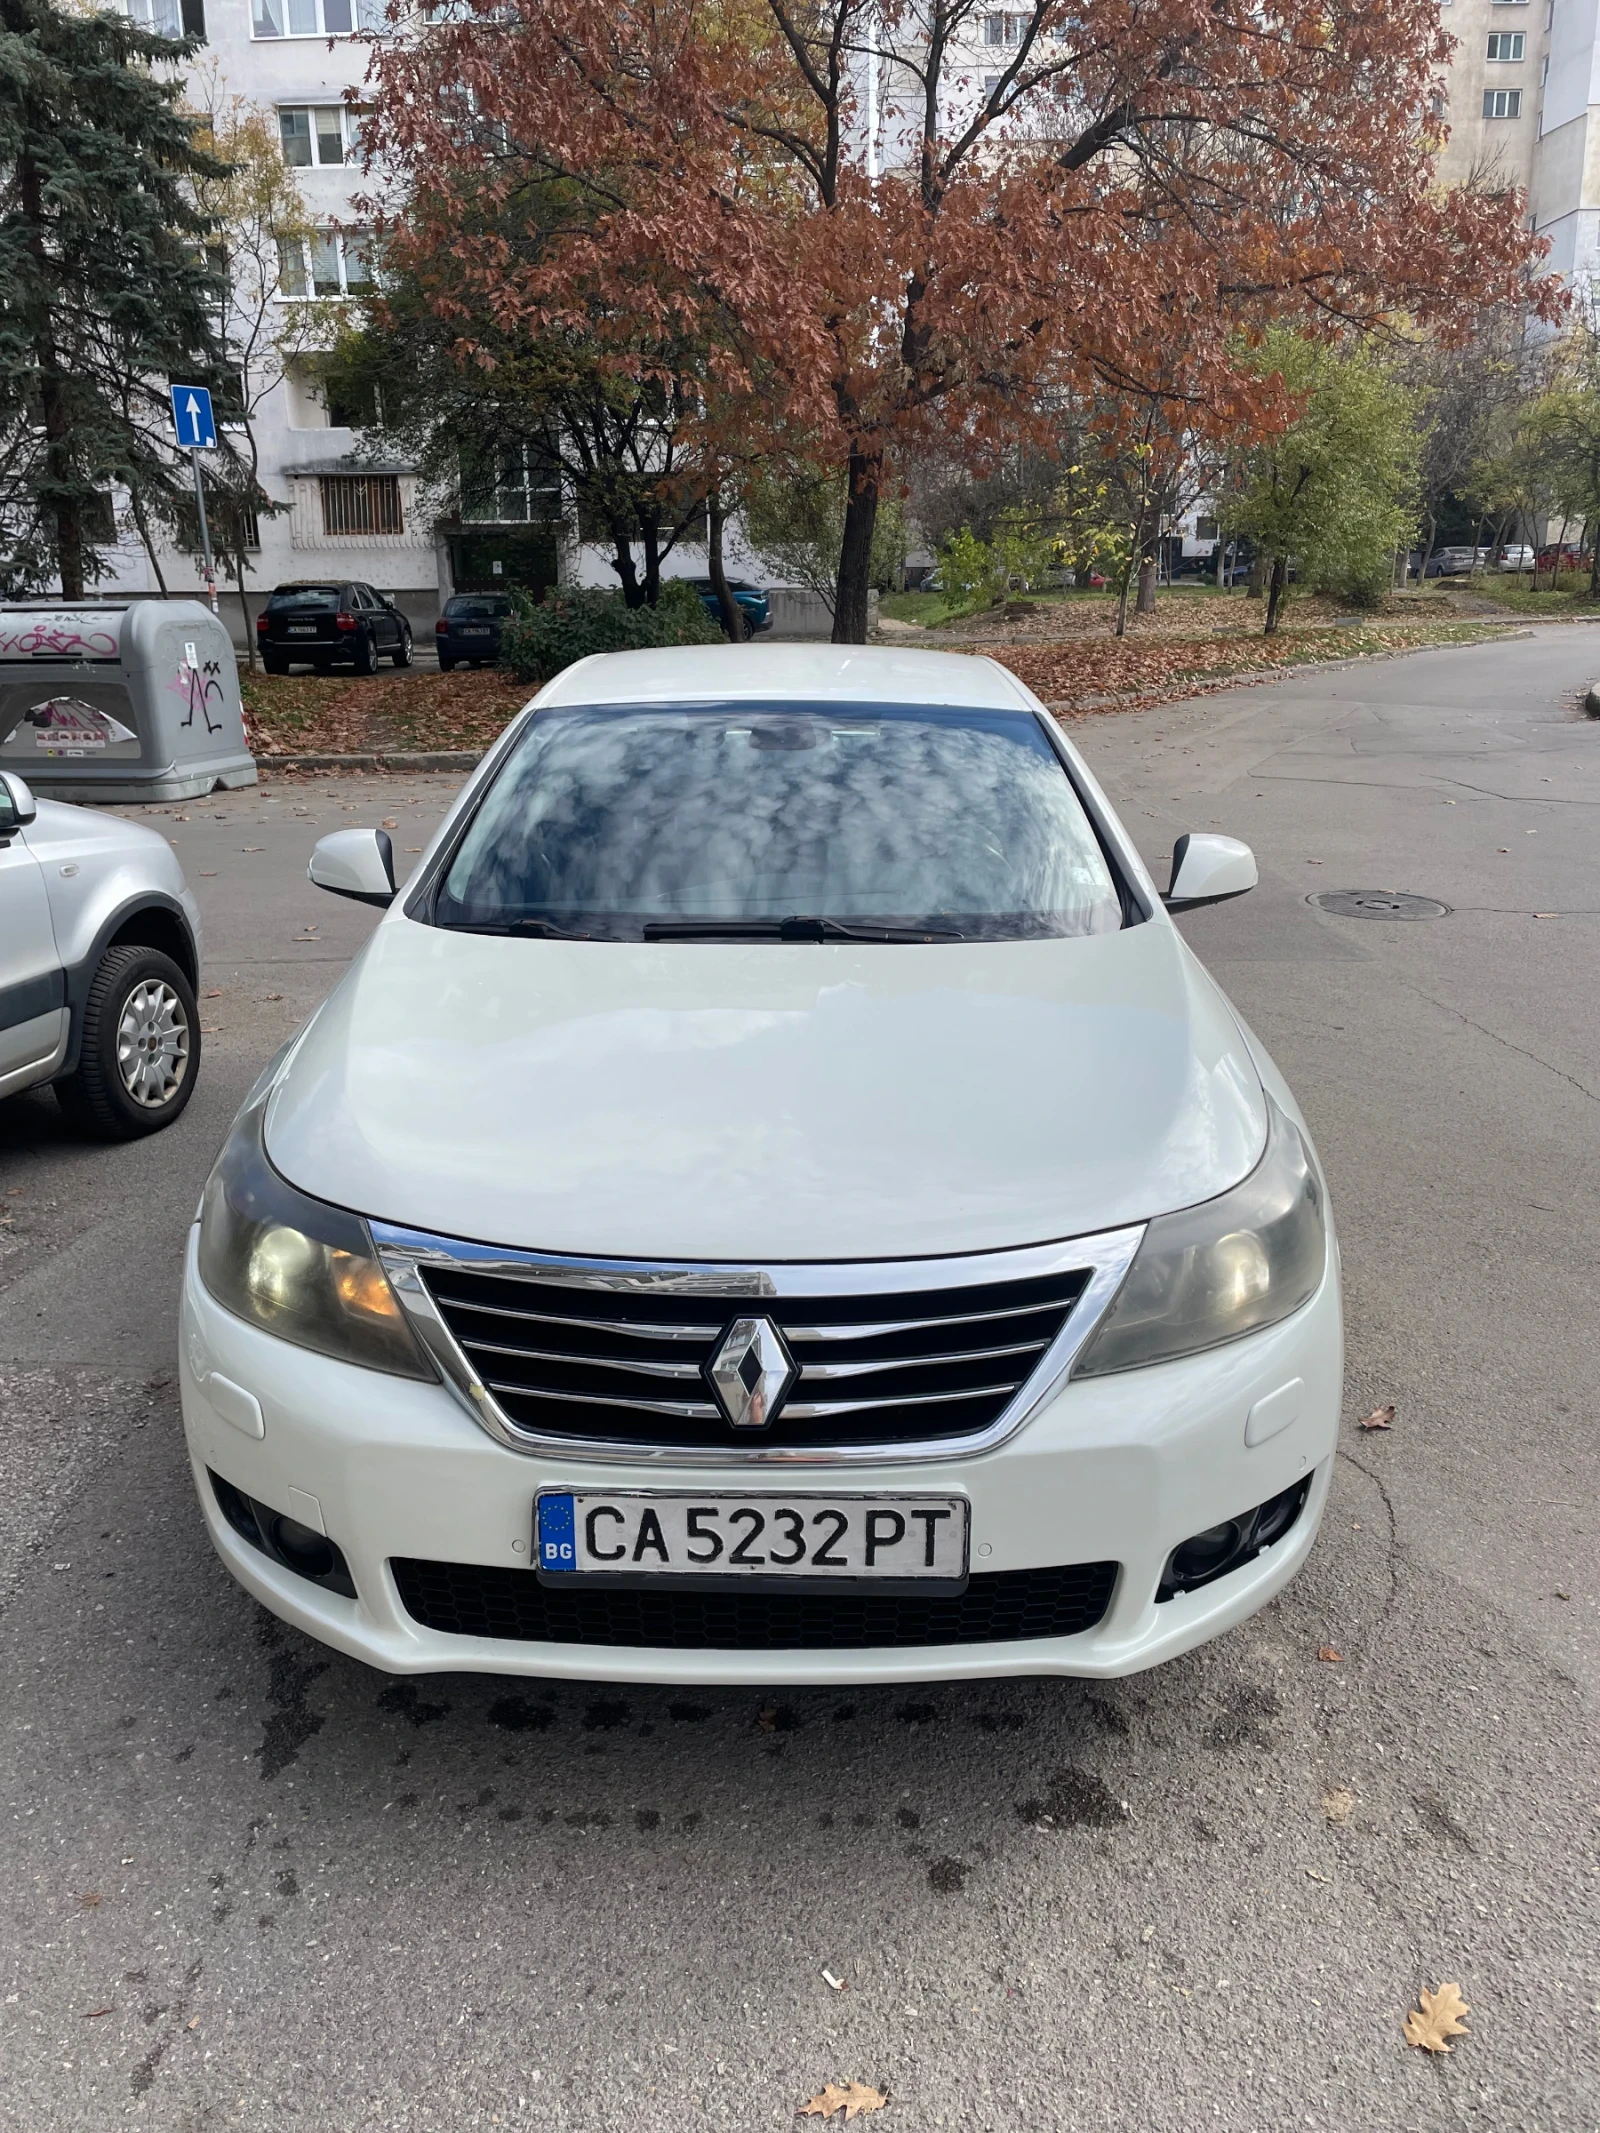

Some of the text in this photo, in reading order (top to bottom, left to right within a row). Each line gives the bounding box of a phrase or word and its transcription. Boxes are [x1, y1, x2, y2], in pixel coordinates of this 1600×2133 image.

[545, 1542, 573, 1560] BG
[585, 1505, 951, 1567] CA 5232 PT
